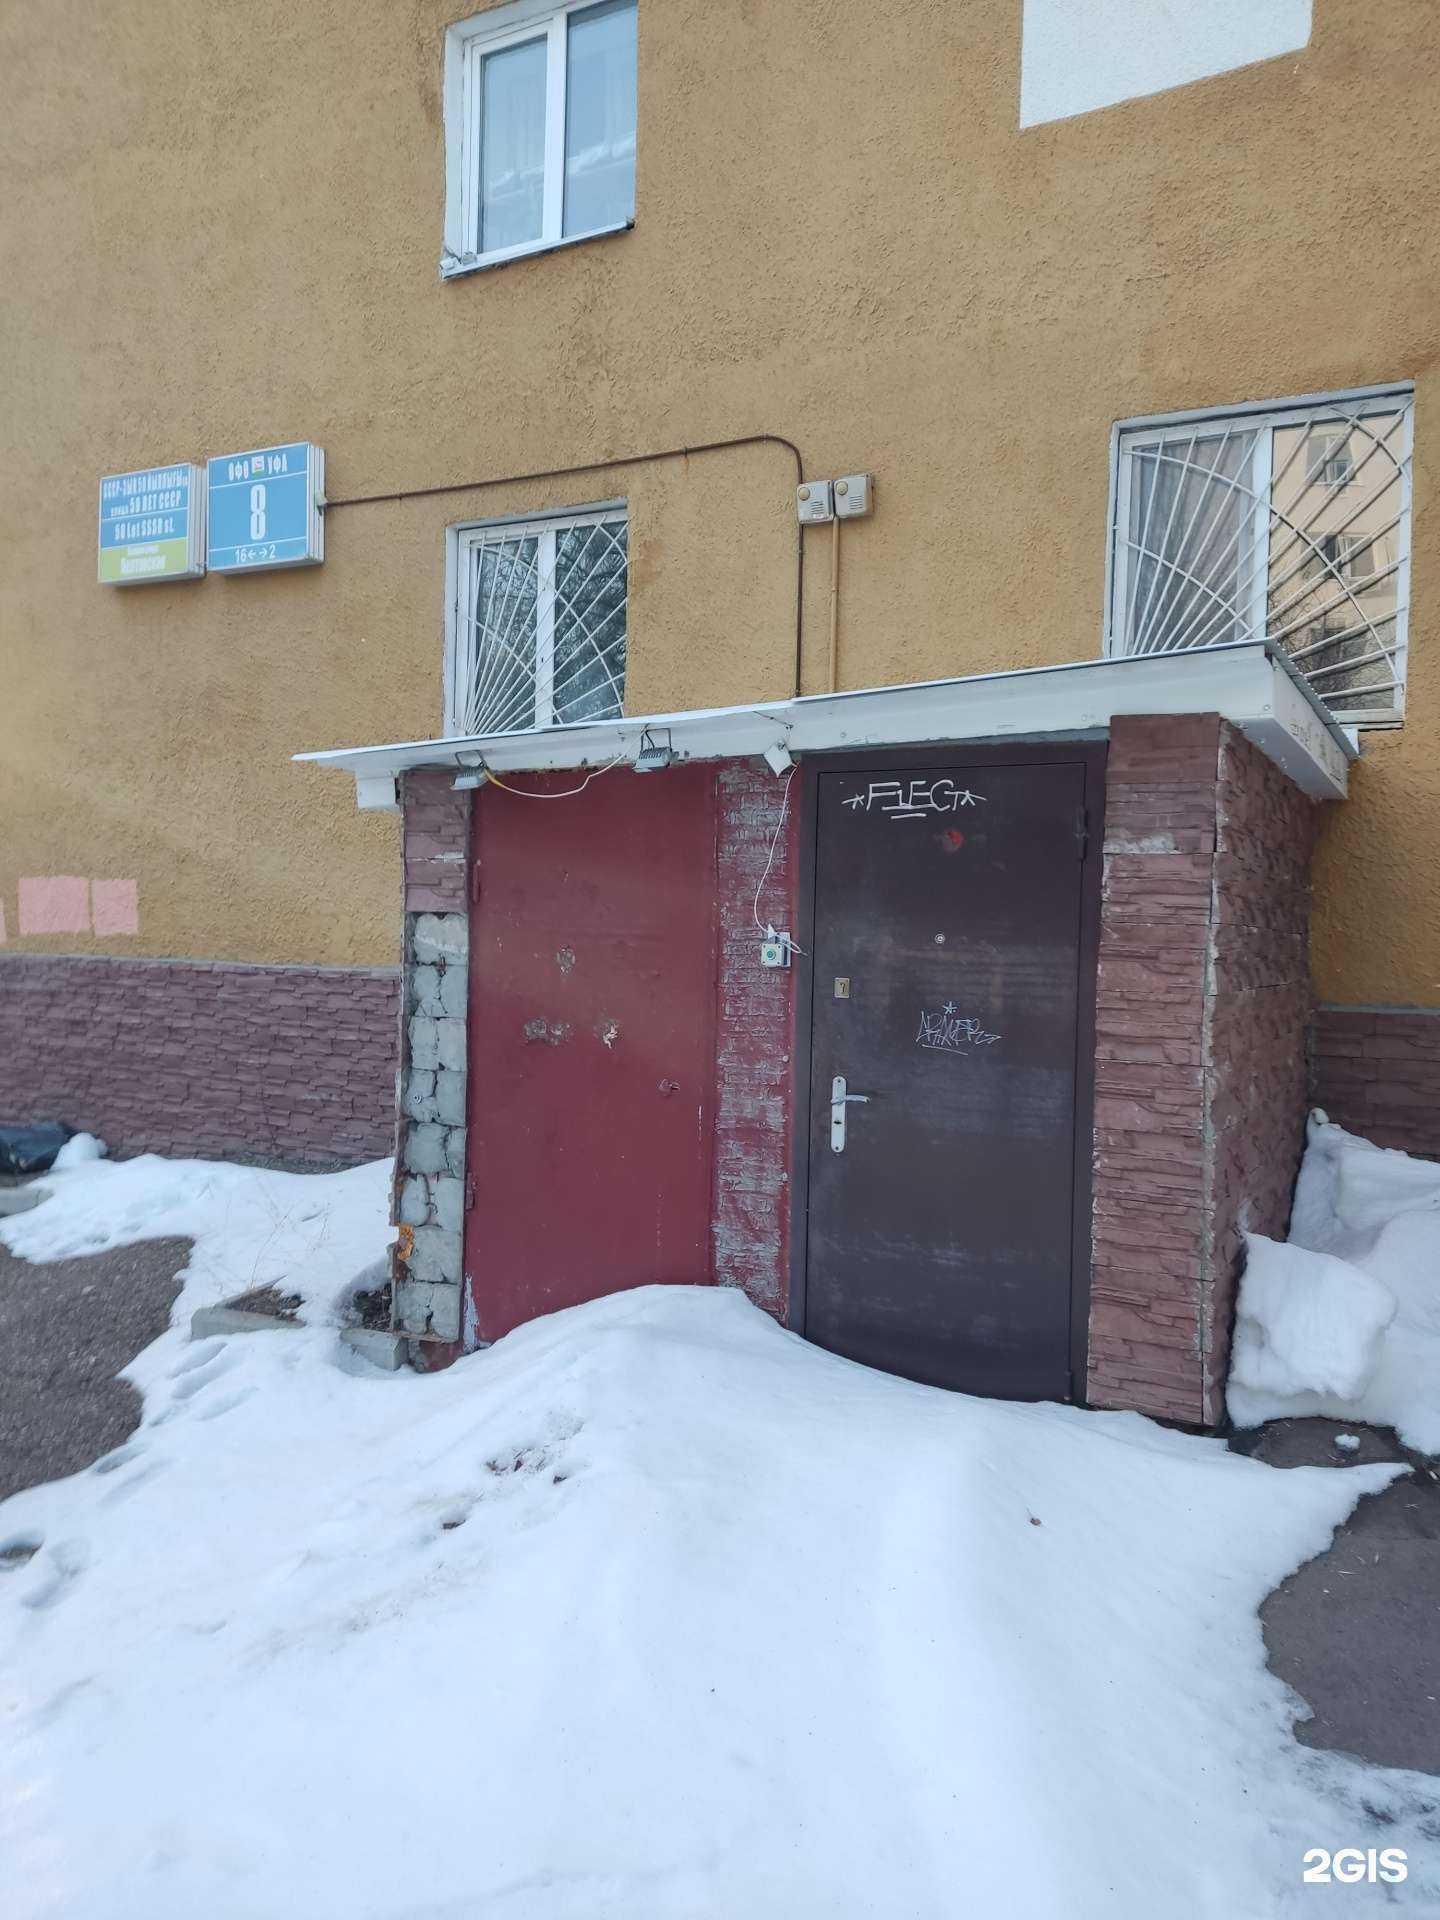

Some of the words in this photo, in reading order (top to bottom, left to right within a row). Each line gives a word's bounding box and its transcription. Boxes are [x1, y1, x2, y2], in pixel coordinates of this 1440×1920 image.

[267, 453, 288, 474] УФА
[130, 497, 141, 514] 50
[142, 494, 158, 512] ЛЕТ
[159, 490, 182, 509] СССР
[250, 484, 266, 540] 8
[115, 523, 126, 540] 50
[235, 548, 247, 563] 16
[269, 544, 277, 559] 2
